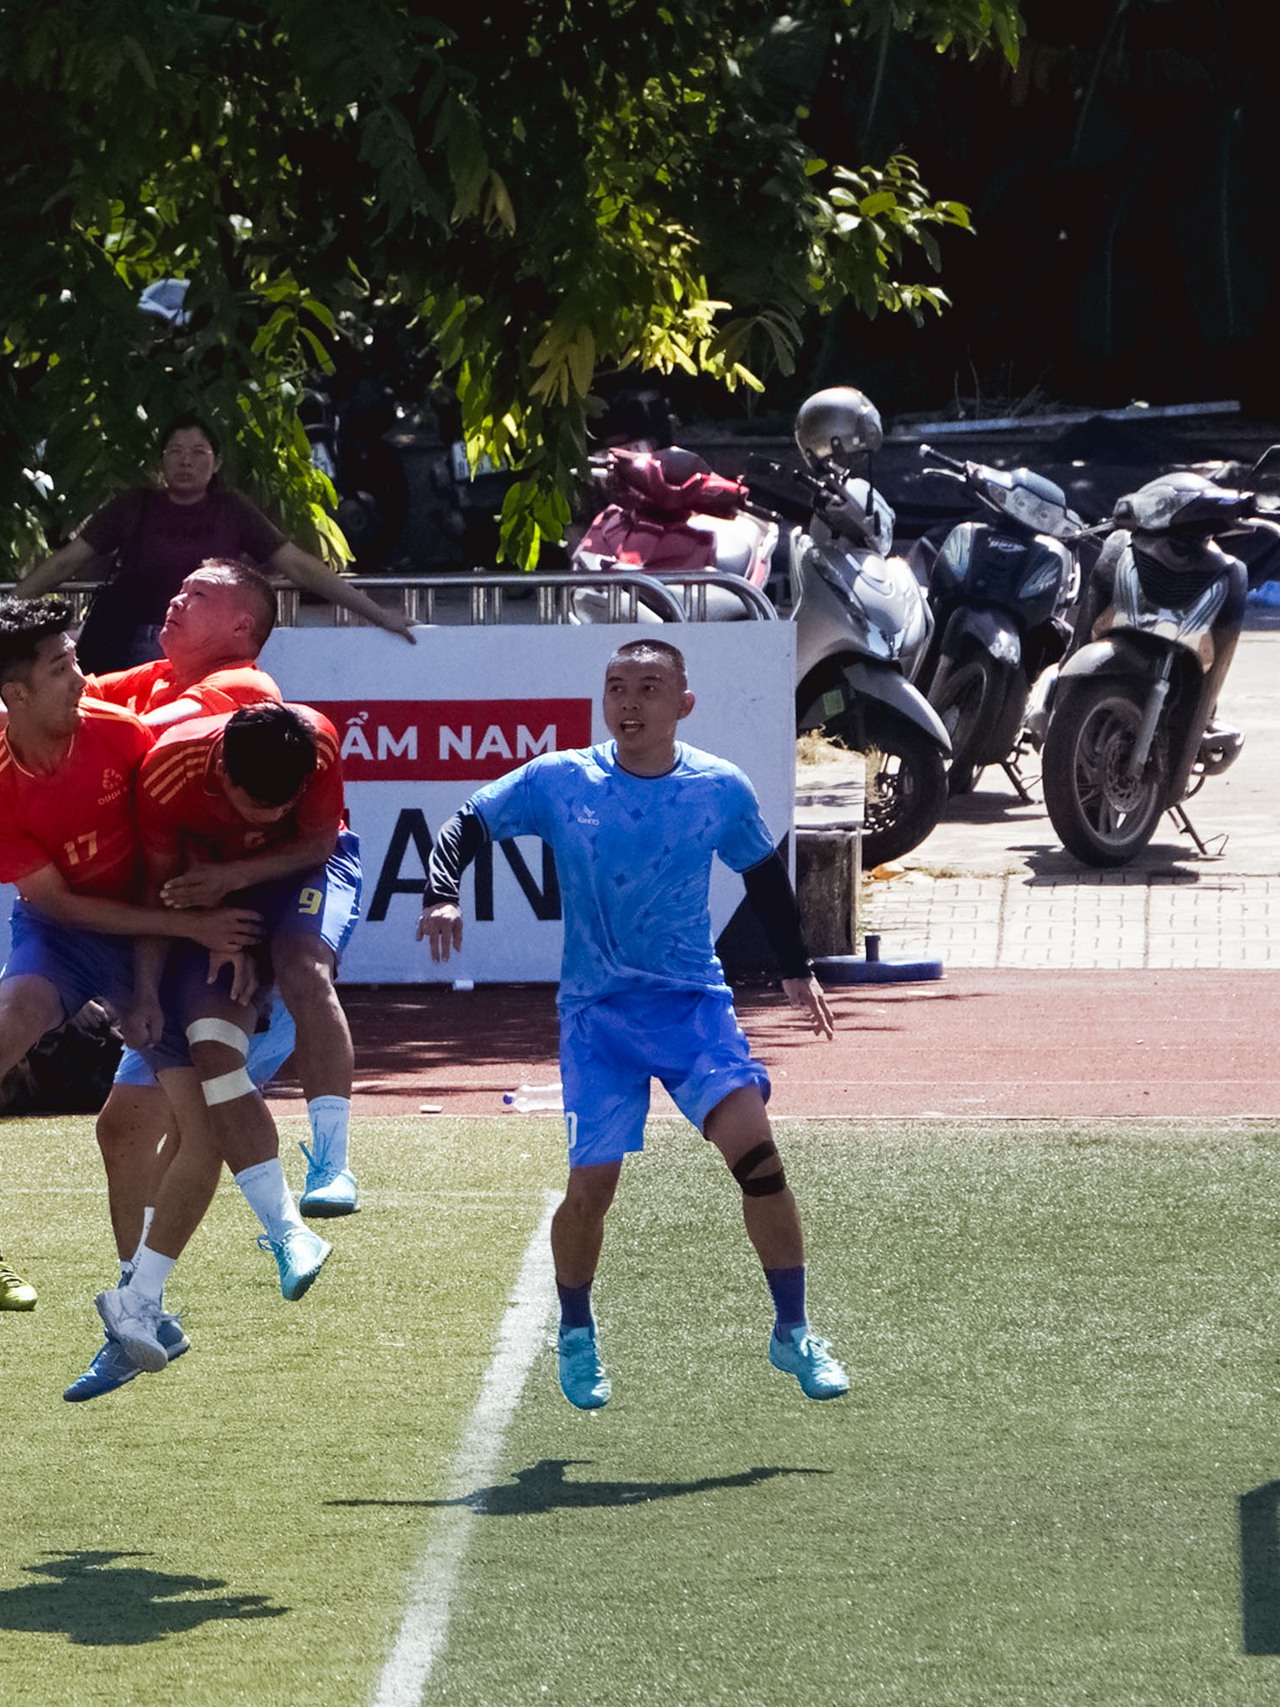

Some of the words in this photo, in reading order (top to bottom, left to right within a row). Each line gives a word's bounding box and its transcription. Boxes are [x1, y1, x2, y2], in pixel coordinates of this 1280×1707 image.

[340, 711, 419, 761] ẨM
[437, 723, 558, 761] NAM
[62, 829, 98, 866] 17
[298, 887, 323, 915] 9
